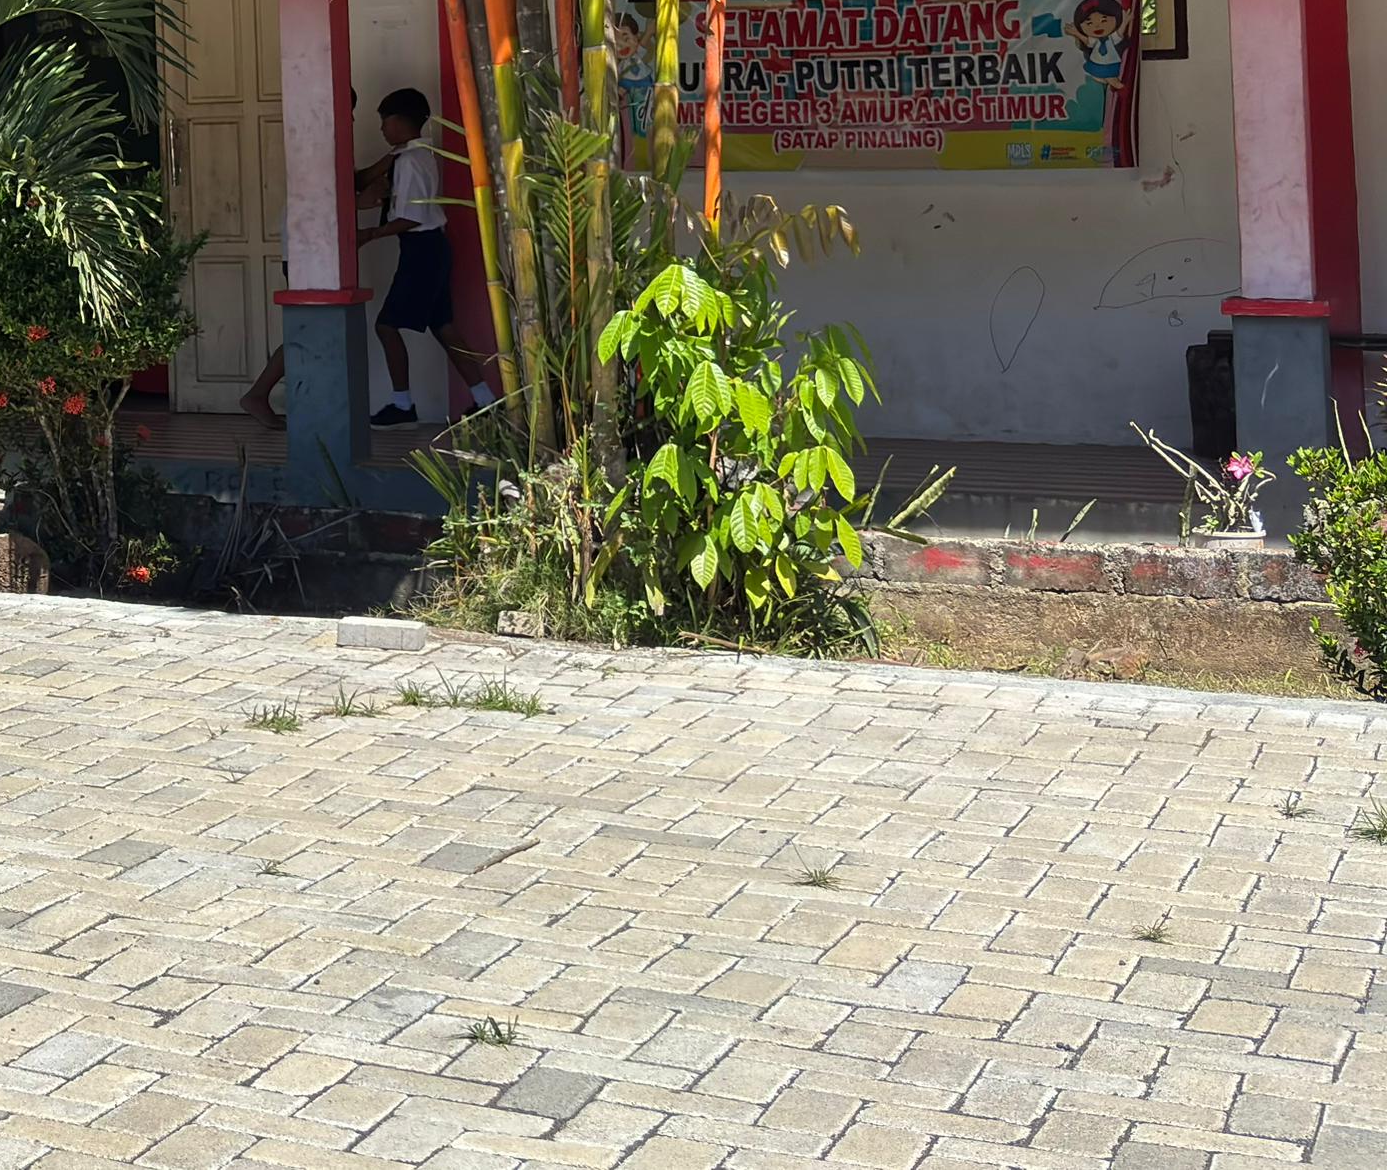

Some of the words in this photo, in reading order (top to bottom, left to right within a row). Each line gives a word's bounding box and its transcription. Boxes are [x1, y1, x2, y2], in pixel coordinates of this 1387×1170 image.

[875, 0, 1021, 46] DATANG
[679, 60, 767, 92] URA
[795, 59, 896, 91] PUTRI
[906, 52, 1065, 88] TERBAIK
[678, 101, 706, 125] MP
[721, 101, 809, 125] NEGERI
[818, 101, 833, 124] 3
[840, 96, 972, 124] AMURANG
[979, 94, 1067, 120] TIMUR
[774, 130, 839, 153] (SATAP
[846, 128, 945, 152] PINALING)
